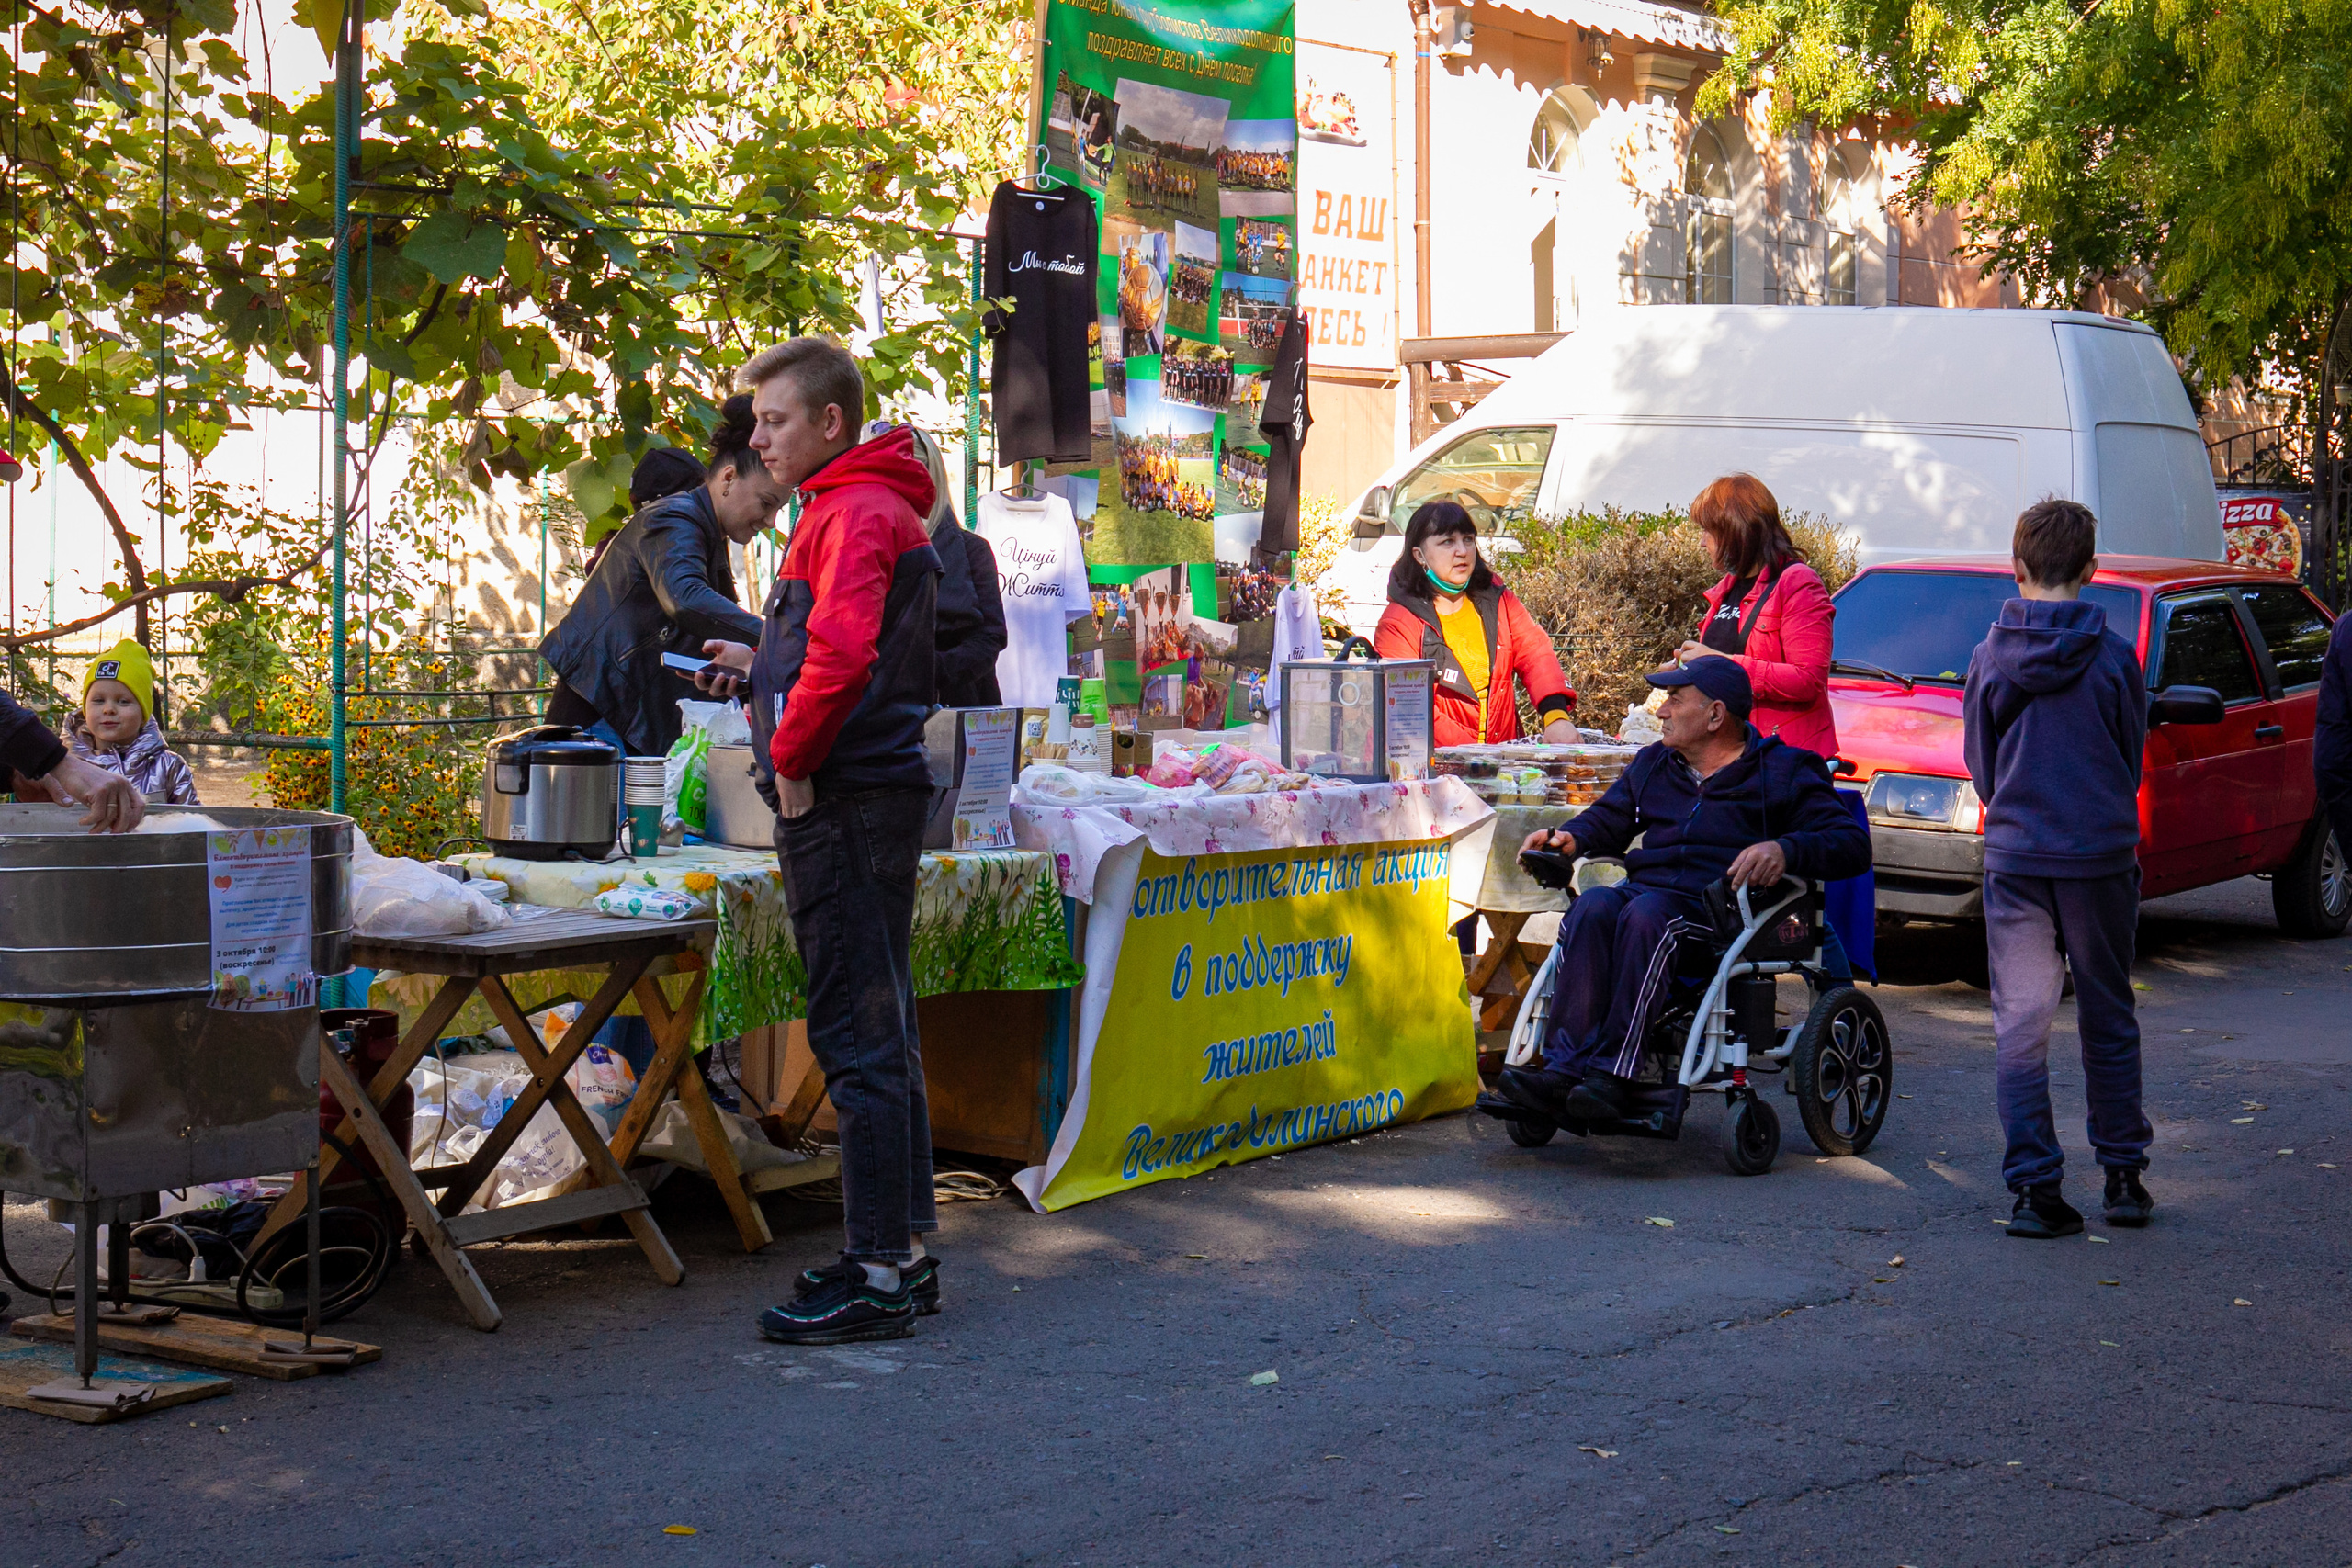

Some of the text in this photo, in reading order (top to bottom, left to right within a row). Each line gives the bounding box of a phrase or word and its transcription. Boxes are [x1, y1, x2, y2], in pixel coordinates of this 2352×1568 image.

[1087, 31, 1162, 63] поздравляет
[1161, 49, 1186, 71] всех
[1189, 54, 1195, 73] с
[1312, 189, 1387, 242] ВАШ
[1009, 251, 1042, 272] Мы
[1047, 254, 1085, 275] тобой
[1299, 254, 1387, 295] АНКЕТ
[1304, 306, 1366, 347] ДЕСЬ
[2220, 502, 2273, 524] izza
[1000, 536, 1057, 570] Цінуй
[1130, 840, 1450, 925] отворительная акция
[220, 958, 275, 970] (воскресенье)
[223, 948, 256, 956] октября
[1170, 932, 1354, 1001] в поддержку
[1201, 1008, 1337, 1085] жителей
